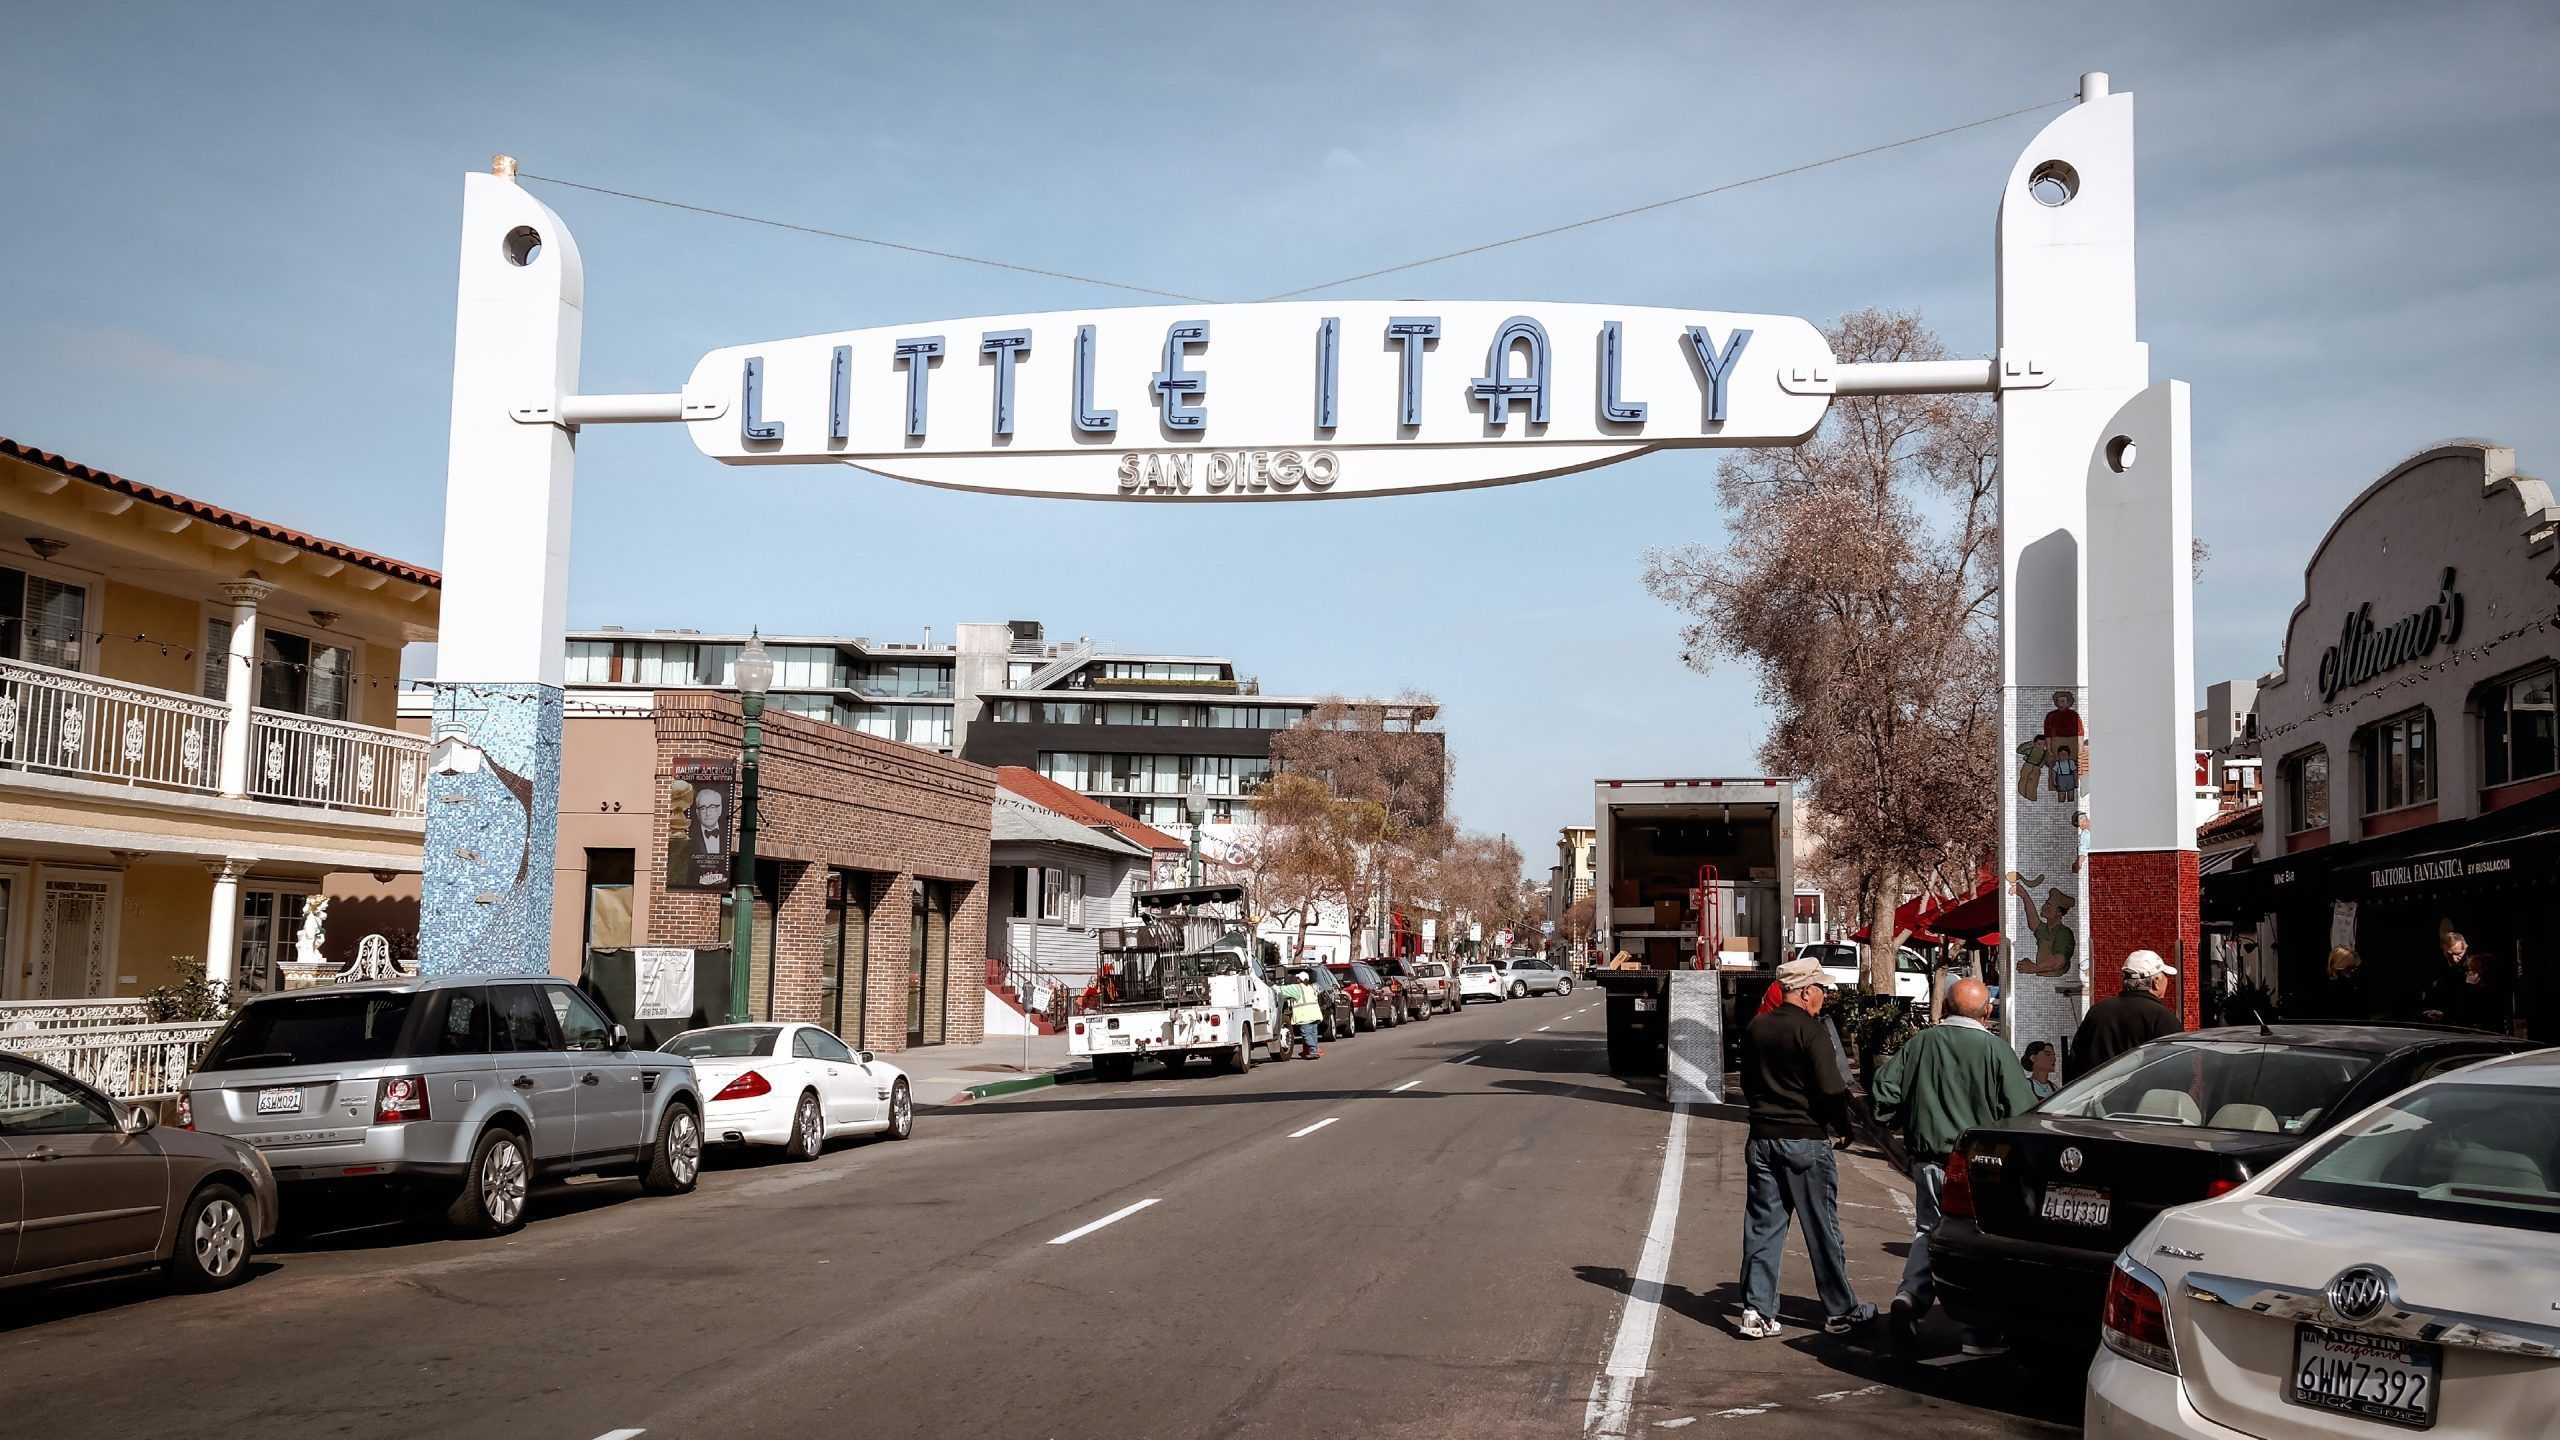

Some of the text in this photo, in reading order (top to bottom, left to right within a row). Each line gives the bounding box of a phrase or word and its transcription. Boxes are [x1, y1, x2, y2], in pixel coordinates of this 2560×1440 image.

[743, 315, 1754, 441] LITTLE ITALY
[1119, 450, 1339, 492] SAN DIEGO
[2319, 567, 2464, 703] Mimmo's
[702, 766, 733, 775] AMERICAN
[2371, 858, 2511, 888] TRATTORIA FANTASTICA BY BUSALACCHI
[283, 1131, 337, 1141] ROVER
[1971, 1154, 2003, 1167] JETTA
[2303, 1331, 2320, 1345] MAY
[2324, 1339, 2412, 1365] California
[2331, 1330, 2400, 1351] TUSTIN
[2300, 1355, 2427, 1413] 6WMZ392
[2297, 1389, 2426, 1424] BUICK GMC
